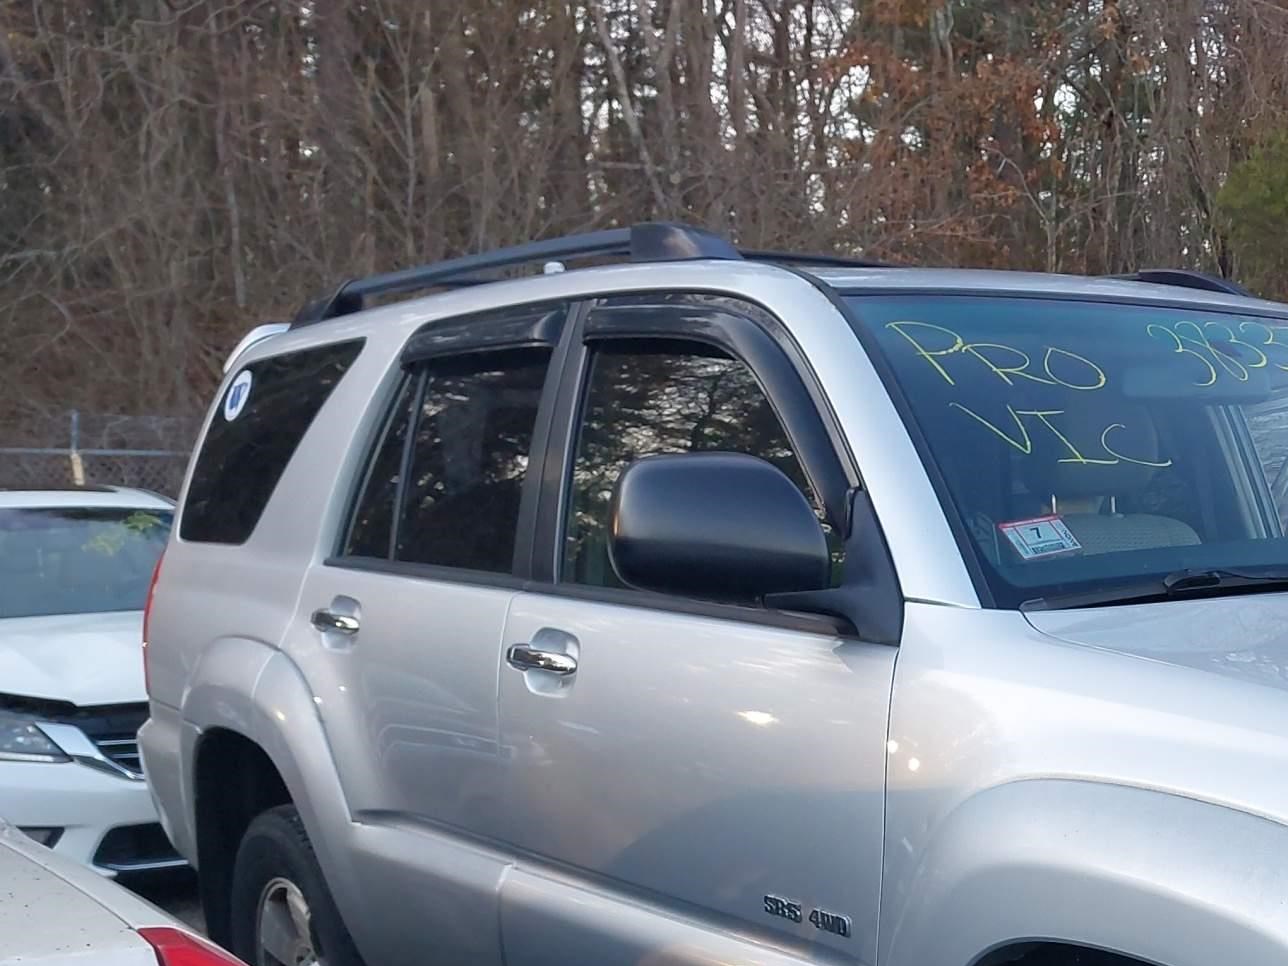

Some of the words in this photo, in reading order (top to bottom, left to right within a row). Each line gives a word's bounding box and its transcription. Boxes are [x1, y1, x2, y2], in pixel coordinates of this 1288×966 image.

[884, 321, 1106, 390] PRO
[949, 402, 1173, 467] VIC
[1029, 526, 1043, 540] 7
[808, 907, 852, 938] 4WD
